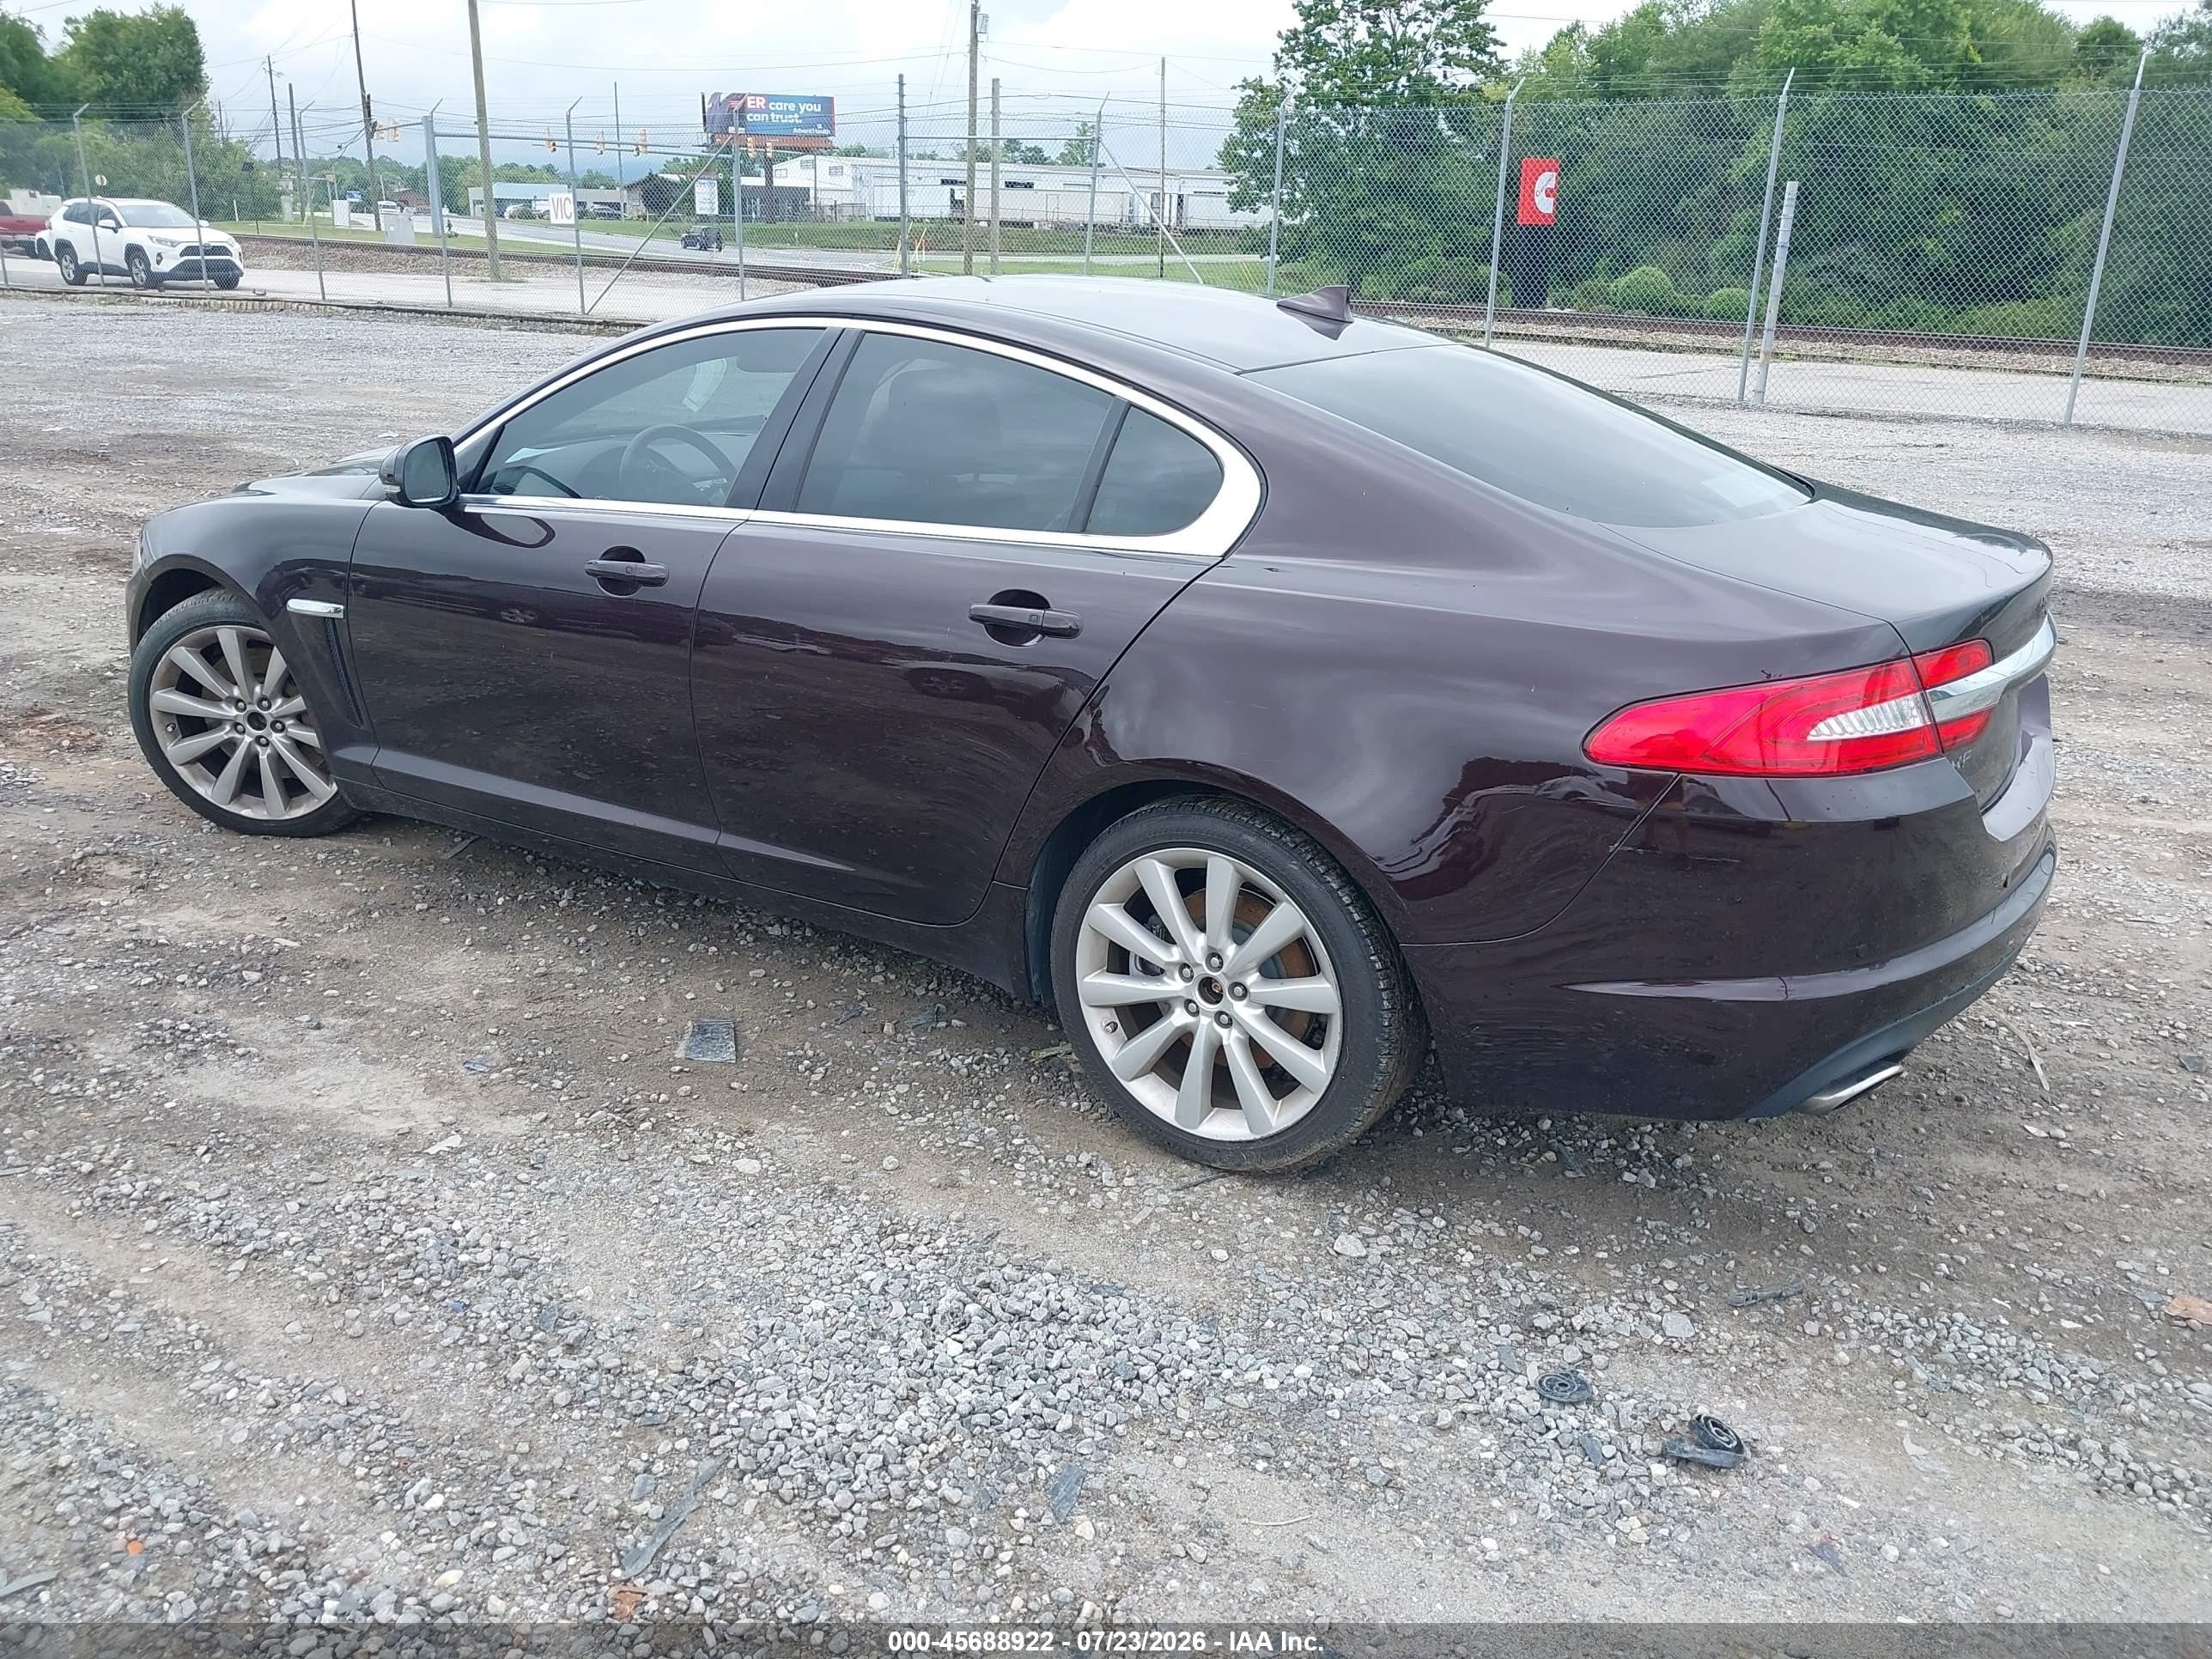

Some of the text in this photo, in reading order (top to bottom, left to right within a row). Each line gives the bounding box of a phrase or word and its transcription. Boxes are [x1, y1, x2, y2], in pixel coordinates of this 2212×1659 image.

[747, 96, 822, 114] ER care you
[746, 112, 803, 123] can trust.
[551, 198, 572, 220] VIC
